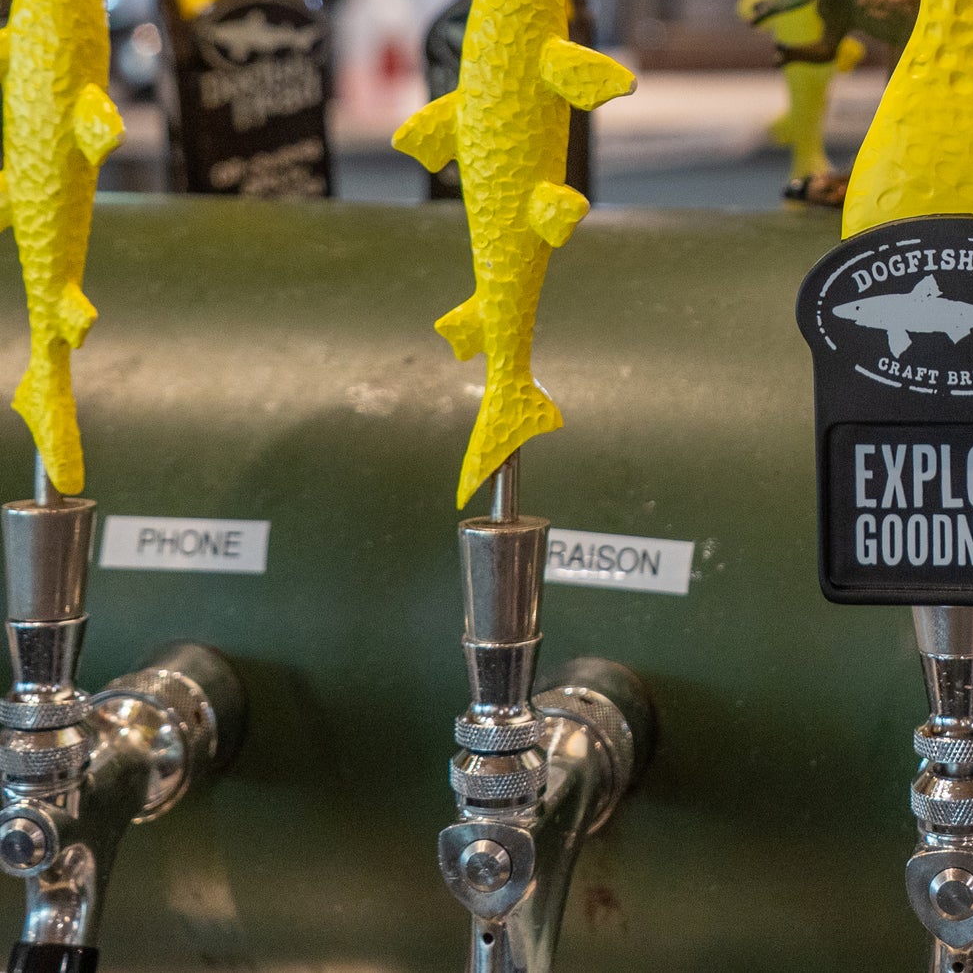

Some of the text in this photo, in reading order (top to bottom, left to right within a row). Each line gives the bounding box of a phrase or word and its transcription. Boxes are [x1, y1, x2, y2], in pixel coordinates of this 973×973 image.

[878, 357, 939, 385] CRAFT
[137, 527, 242, 558] PHONE
[549, 540, 661, 575] RAISON
